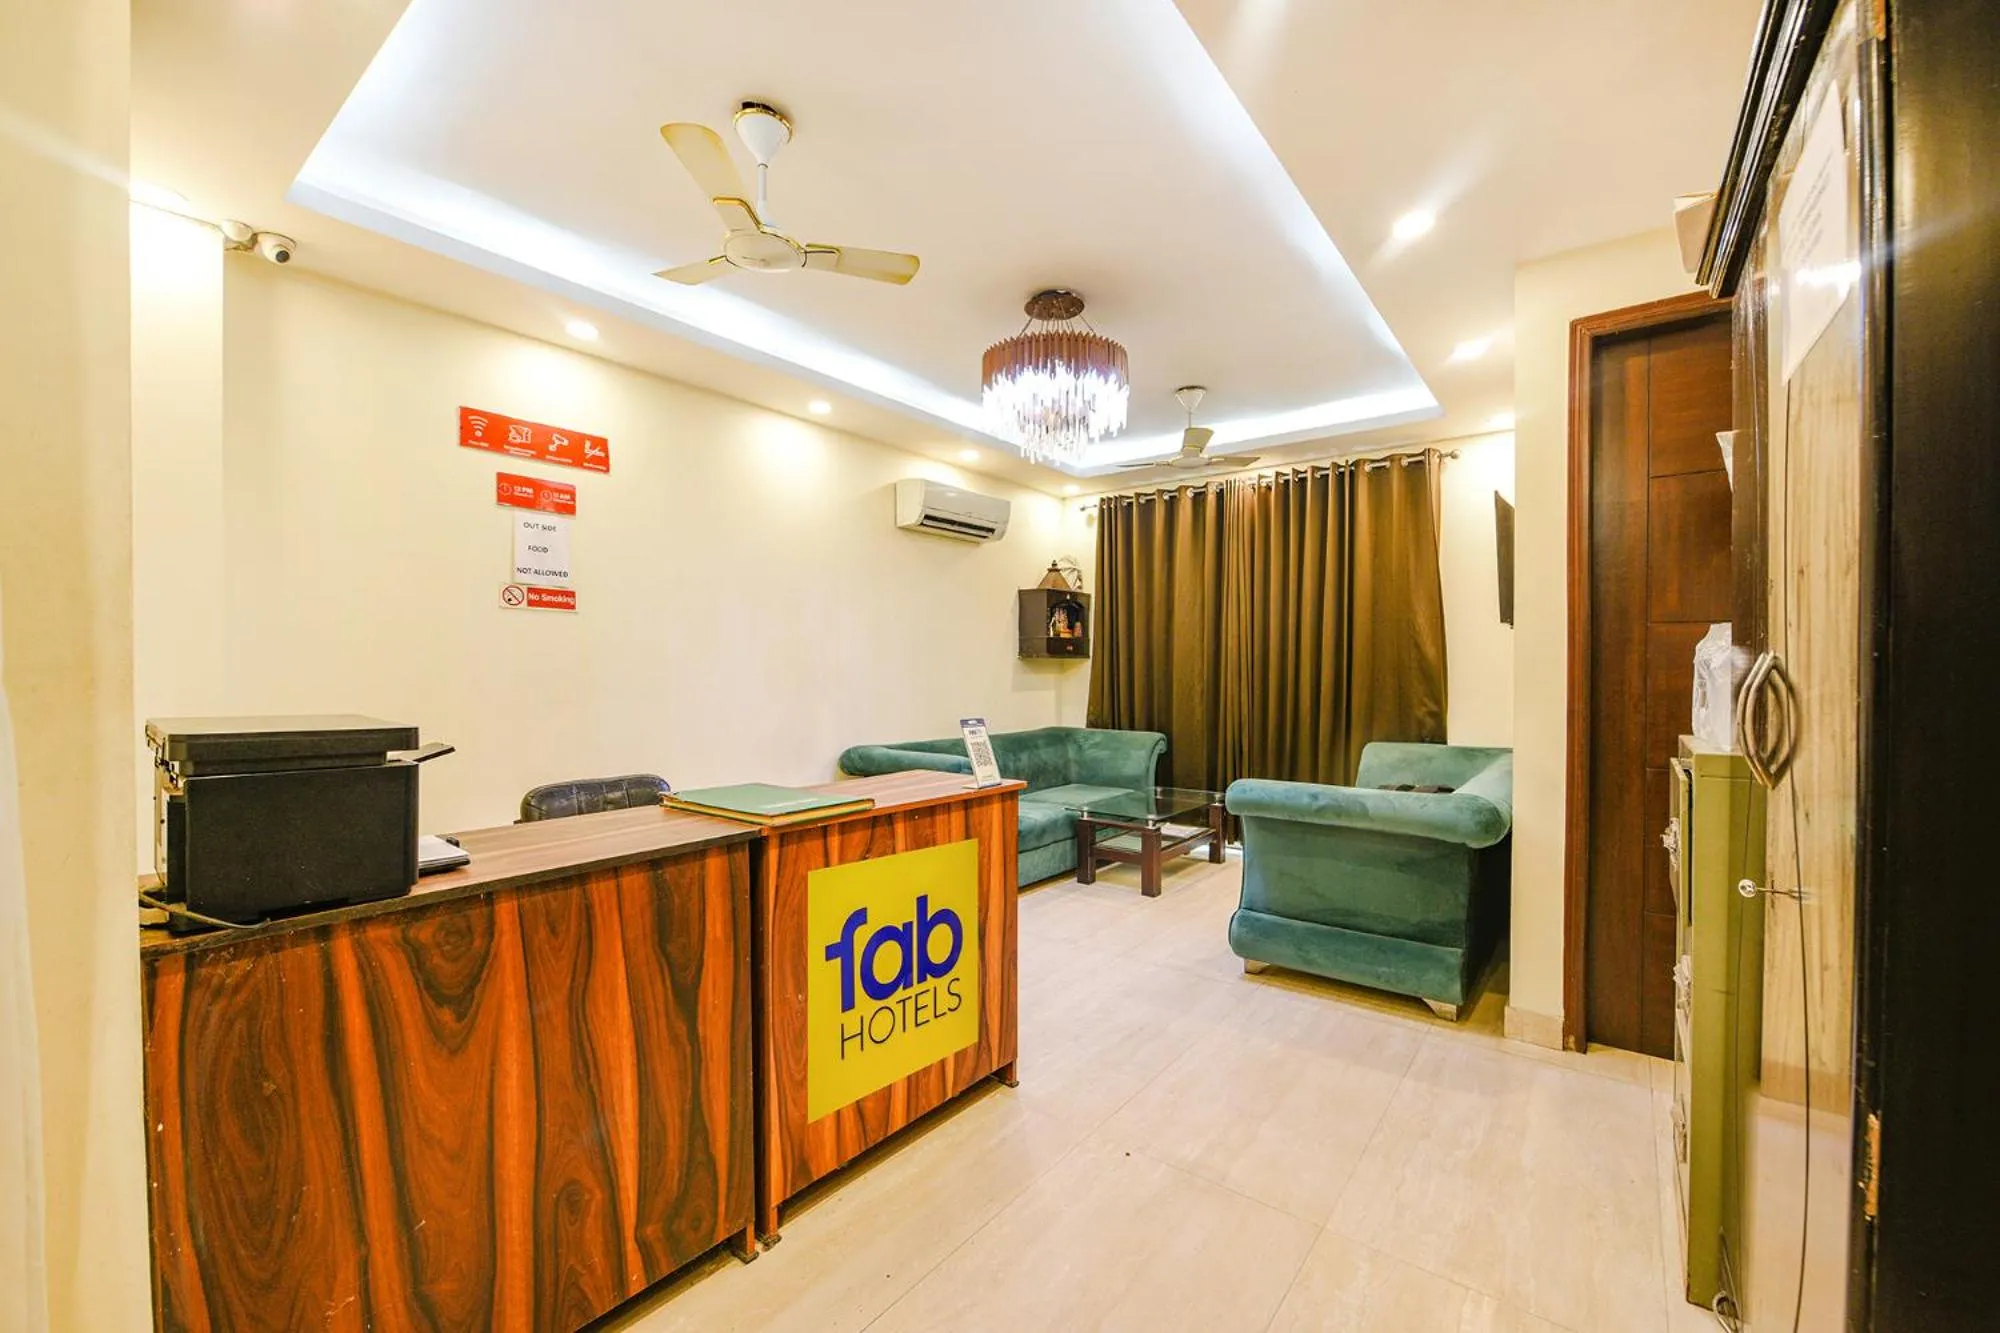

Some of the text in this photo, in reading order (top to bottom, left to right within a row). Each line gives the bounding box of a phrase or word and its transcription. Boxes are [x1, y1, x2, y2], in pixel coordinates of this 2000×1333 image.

[523, 521, 557, 532] OUT SIDE
[528, 545, 549, 553] FOOD
[517, 567, 569, 578] NOT ALLOWED
[528, 592, 576, 605] No Smoking
[825, 894, 963, 1014] fab
[841, 977, 962, 1060] HOTELS
